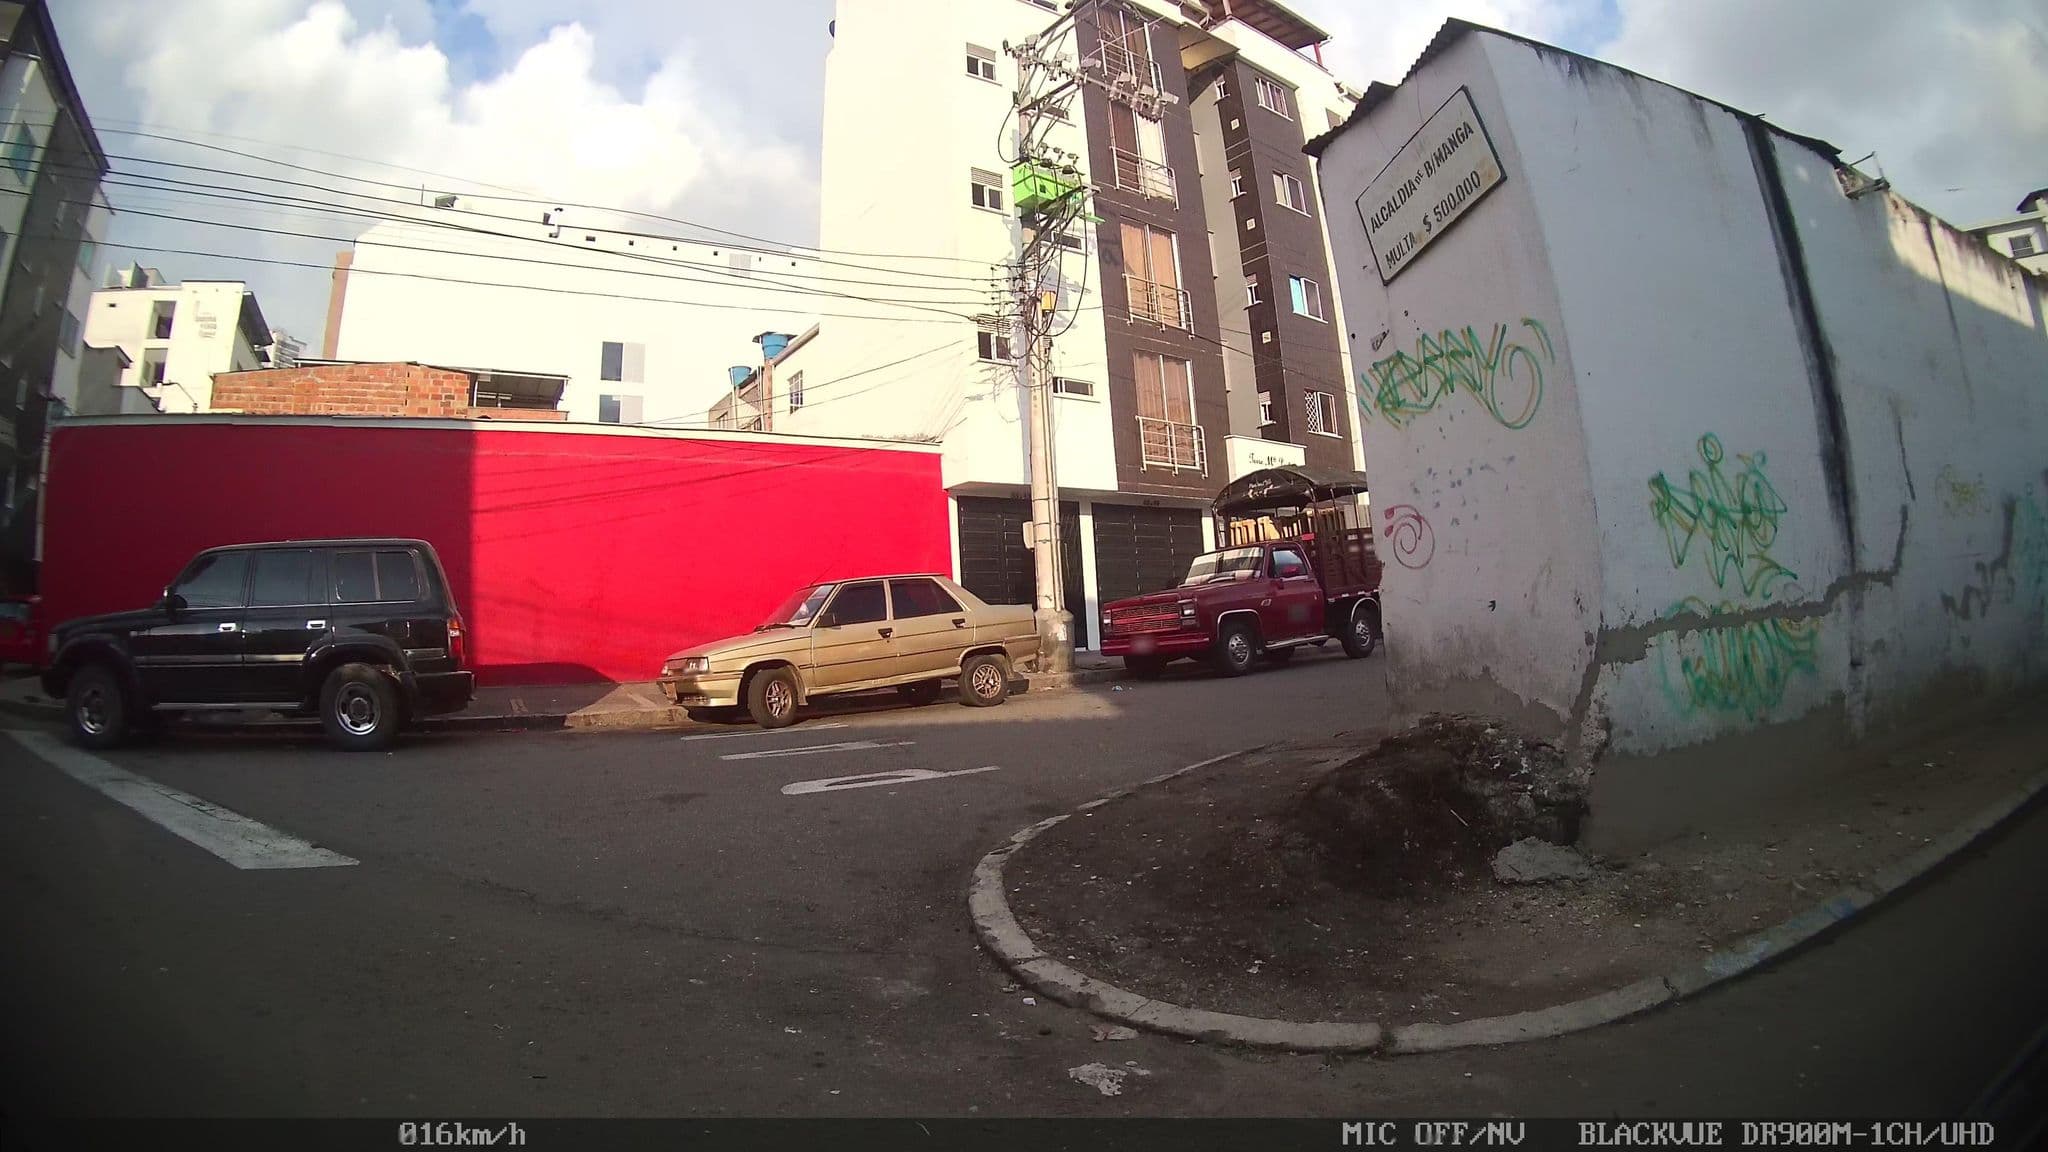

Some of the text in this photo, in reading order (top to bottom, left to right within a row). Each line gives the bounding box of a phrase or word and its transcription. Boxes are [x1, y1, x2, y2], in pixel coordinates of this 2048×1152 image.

[1370, 178, 1418, 234] ALCALDIA
[1423, 120, 1475, 179] B/MANGA
[1385, 169, 1482, 270] MULTA $ 500.000
